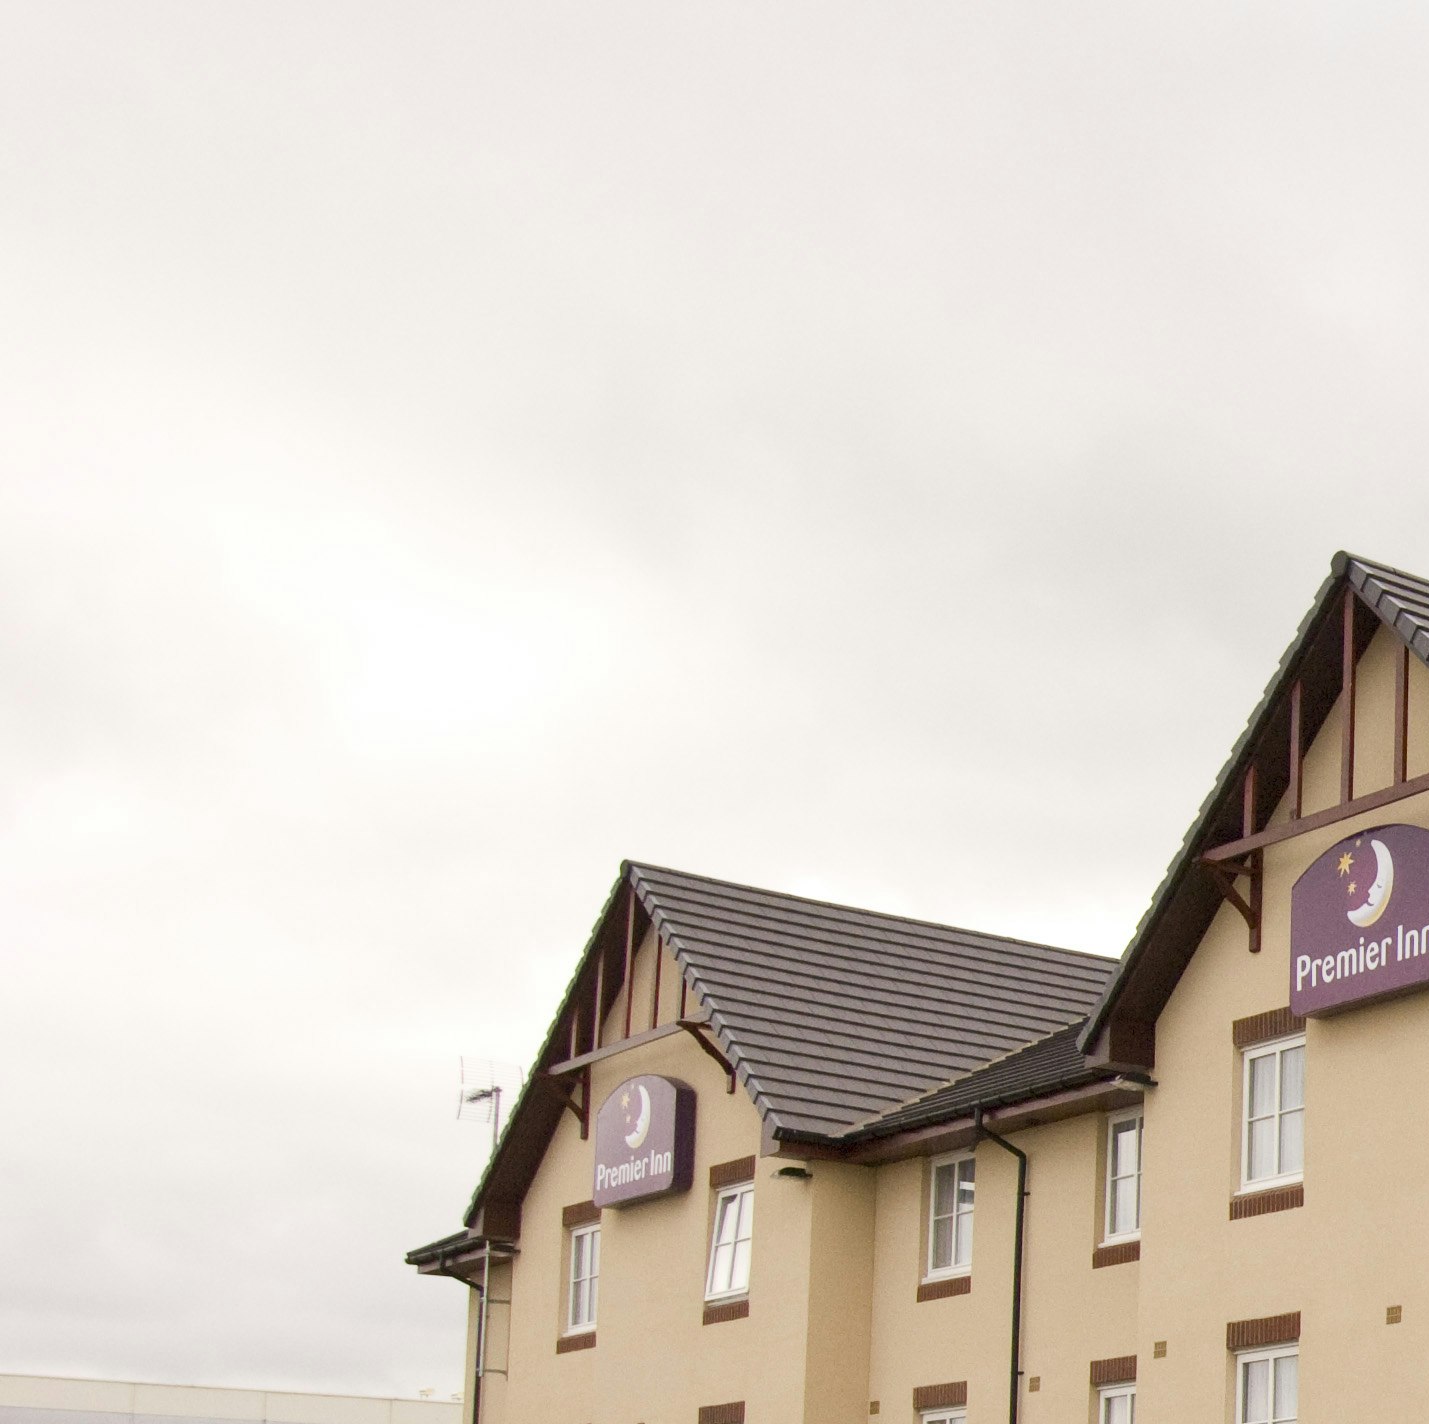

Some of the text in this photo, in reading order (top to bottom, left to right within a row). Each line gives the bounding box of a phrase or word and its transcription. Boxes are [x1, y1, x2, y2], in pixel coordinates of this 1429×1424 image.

[1296, 936, 1392, 991] Premier
[596, 1150, 672, 1190] Premier Inn
